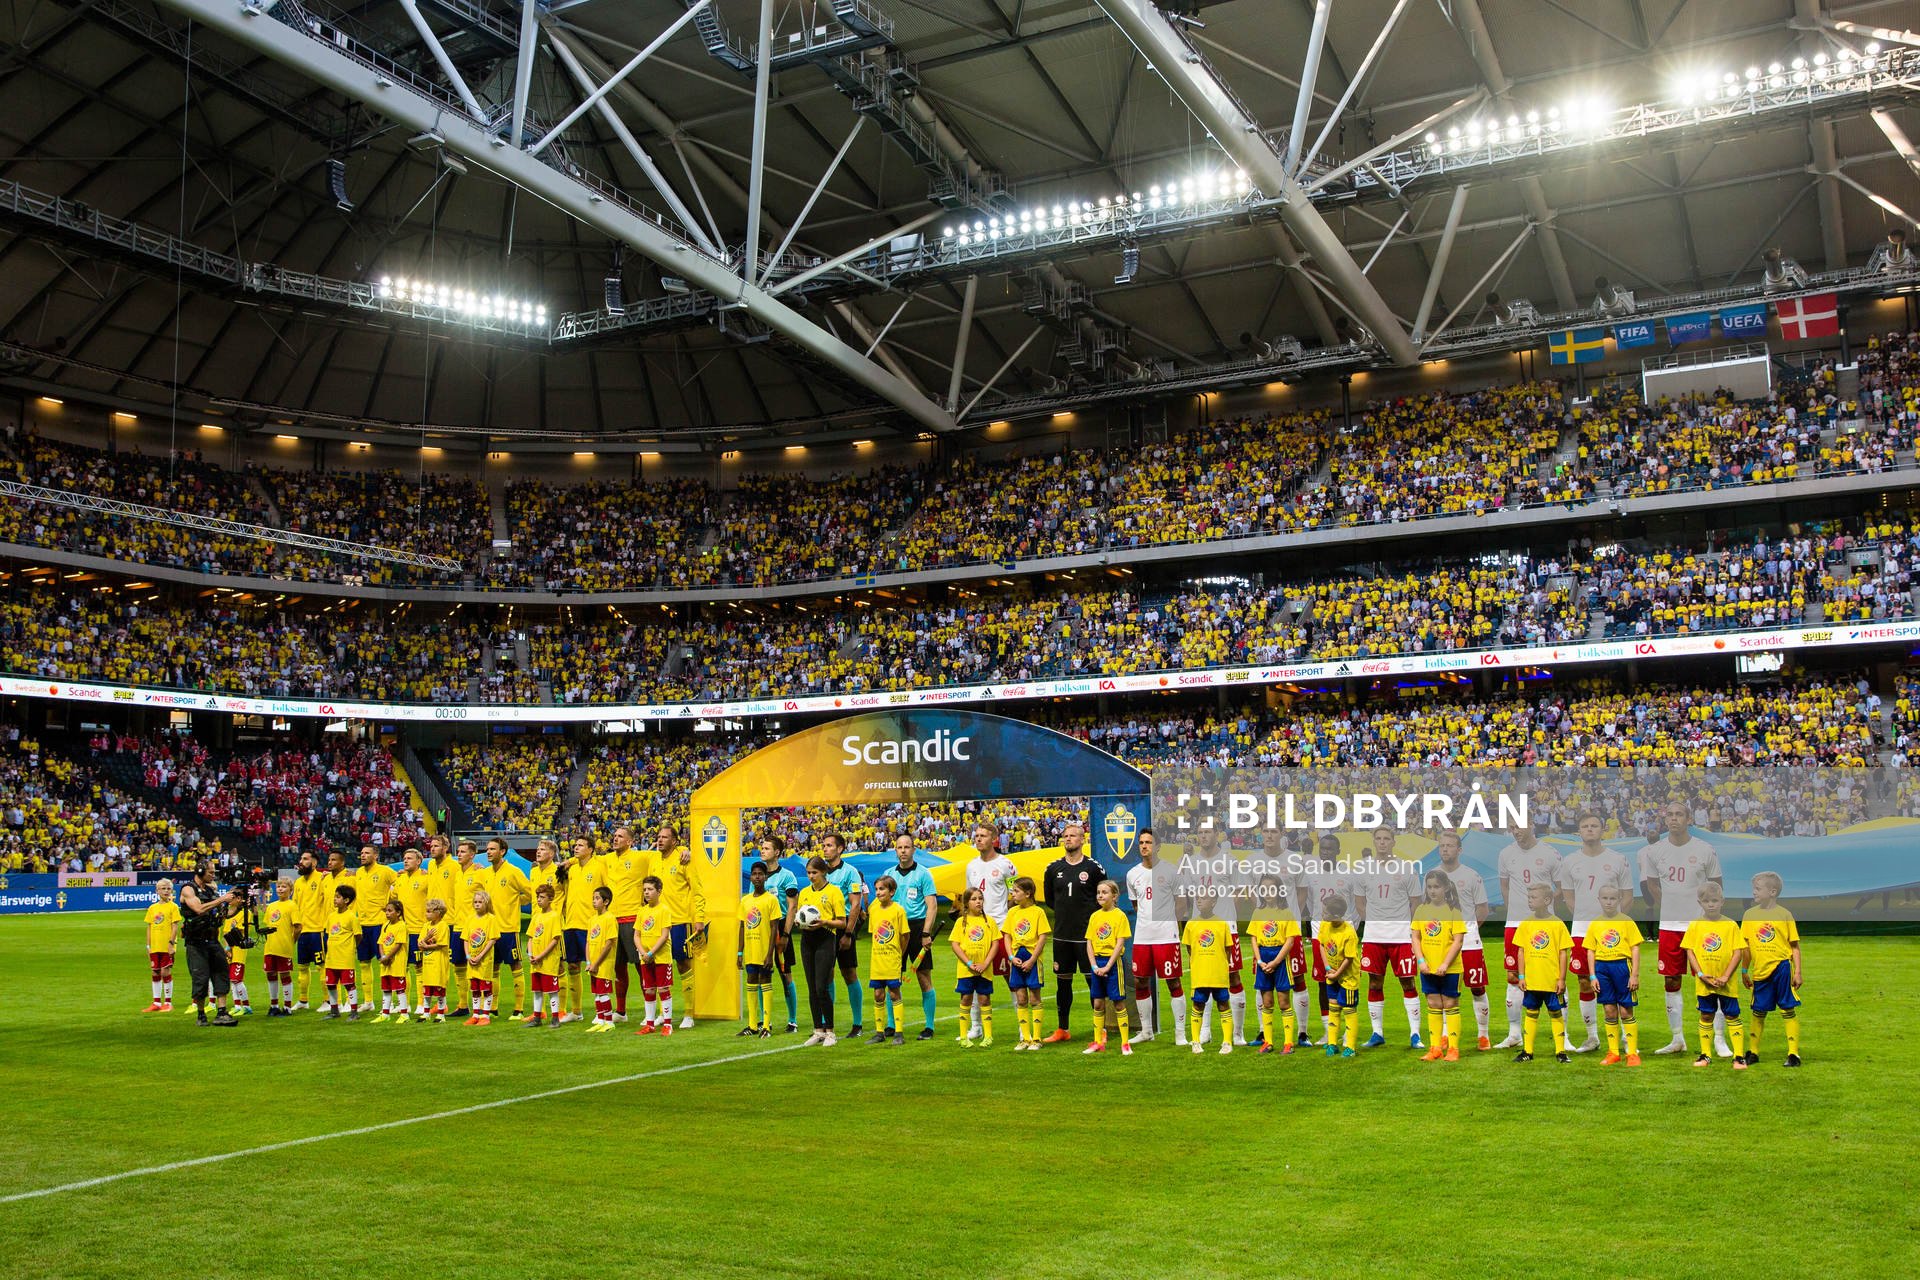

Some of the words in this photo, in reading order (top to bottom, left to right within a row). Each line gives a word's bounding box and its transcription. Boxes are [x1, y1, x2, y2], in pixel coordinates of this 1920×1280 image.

[1723, 314, 1763, 328] UEFA
[1619, 326, 1649, 339] FIFA
[1740, 635, 1784, 647] Scandic
[1802, 631, 1832, 641] SPORT
[1577, 647, 1623, 658] Folksam
[1635, 644, 1656, 655] ICA
[1425, 658, 1468, 669] Folksam
[1480, 654, 1500, 665] ICA
[1226, 671, 1249, 680] SPORT
[1270, 667, 1324, 678] INTERSPORT
[1179, 674, 1213, 684] Scandic
[1054, 683, 1090, 693] Folksam
[1099, 680, 1115, 691] ICA
[68, 687, 101, 698] Scandic
[926, 691, 971, 700] INTERSPORT
[152, 695, 197, 705] INTERSPORT
[851, 696, 879, 706] Scandic
[272, 703, 308, 713] Folksam
[319, 705, 335, 715] ICA
[747, 704, 777, 713] Folksam
[784, 701, 798, 711] ICA
[435, 708, 467, 718] 00:00
[651, 708, 670, 716] PORT
[843, 729, 970, 767] Scandic
[864, 781, 900, 790] OFFICIELL
[902, 778, 949, 789] MATCHVÅRD
[1523, 869, 1531, 884] 9
[1669, 866, 1686, 883] 20
[66, 877, 93, 888] SPORT
[104, 877, 129, 887] SPORT
[979, 878, 986, 892] 4
[1588, 875, 1596, 891] 7
[1067, 882, 1073, 897] 1
[1146, 886, 1153, 900] 8
[1378, 884, 1390, 899] 17
[999, 958, 1006, 972] 4
[1164, 961, 1173, 976] 8
[1291, 958, 1299, 973] 6
[1400, 958, 1412, 974] 17
[1469, 968, 1483, 984] 27
